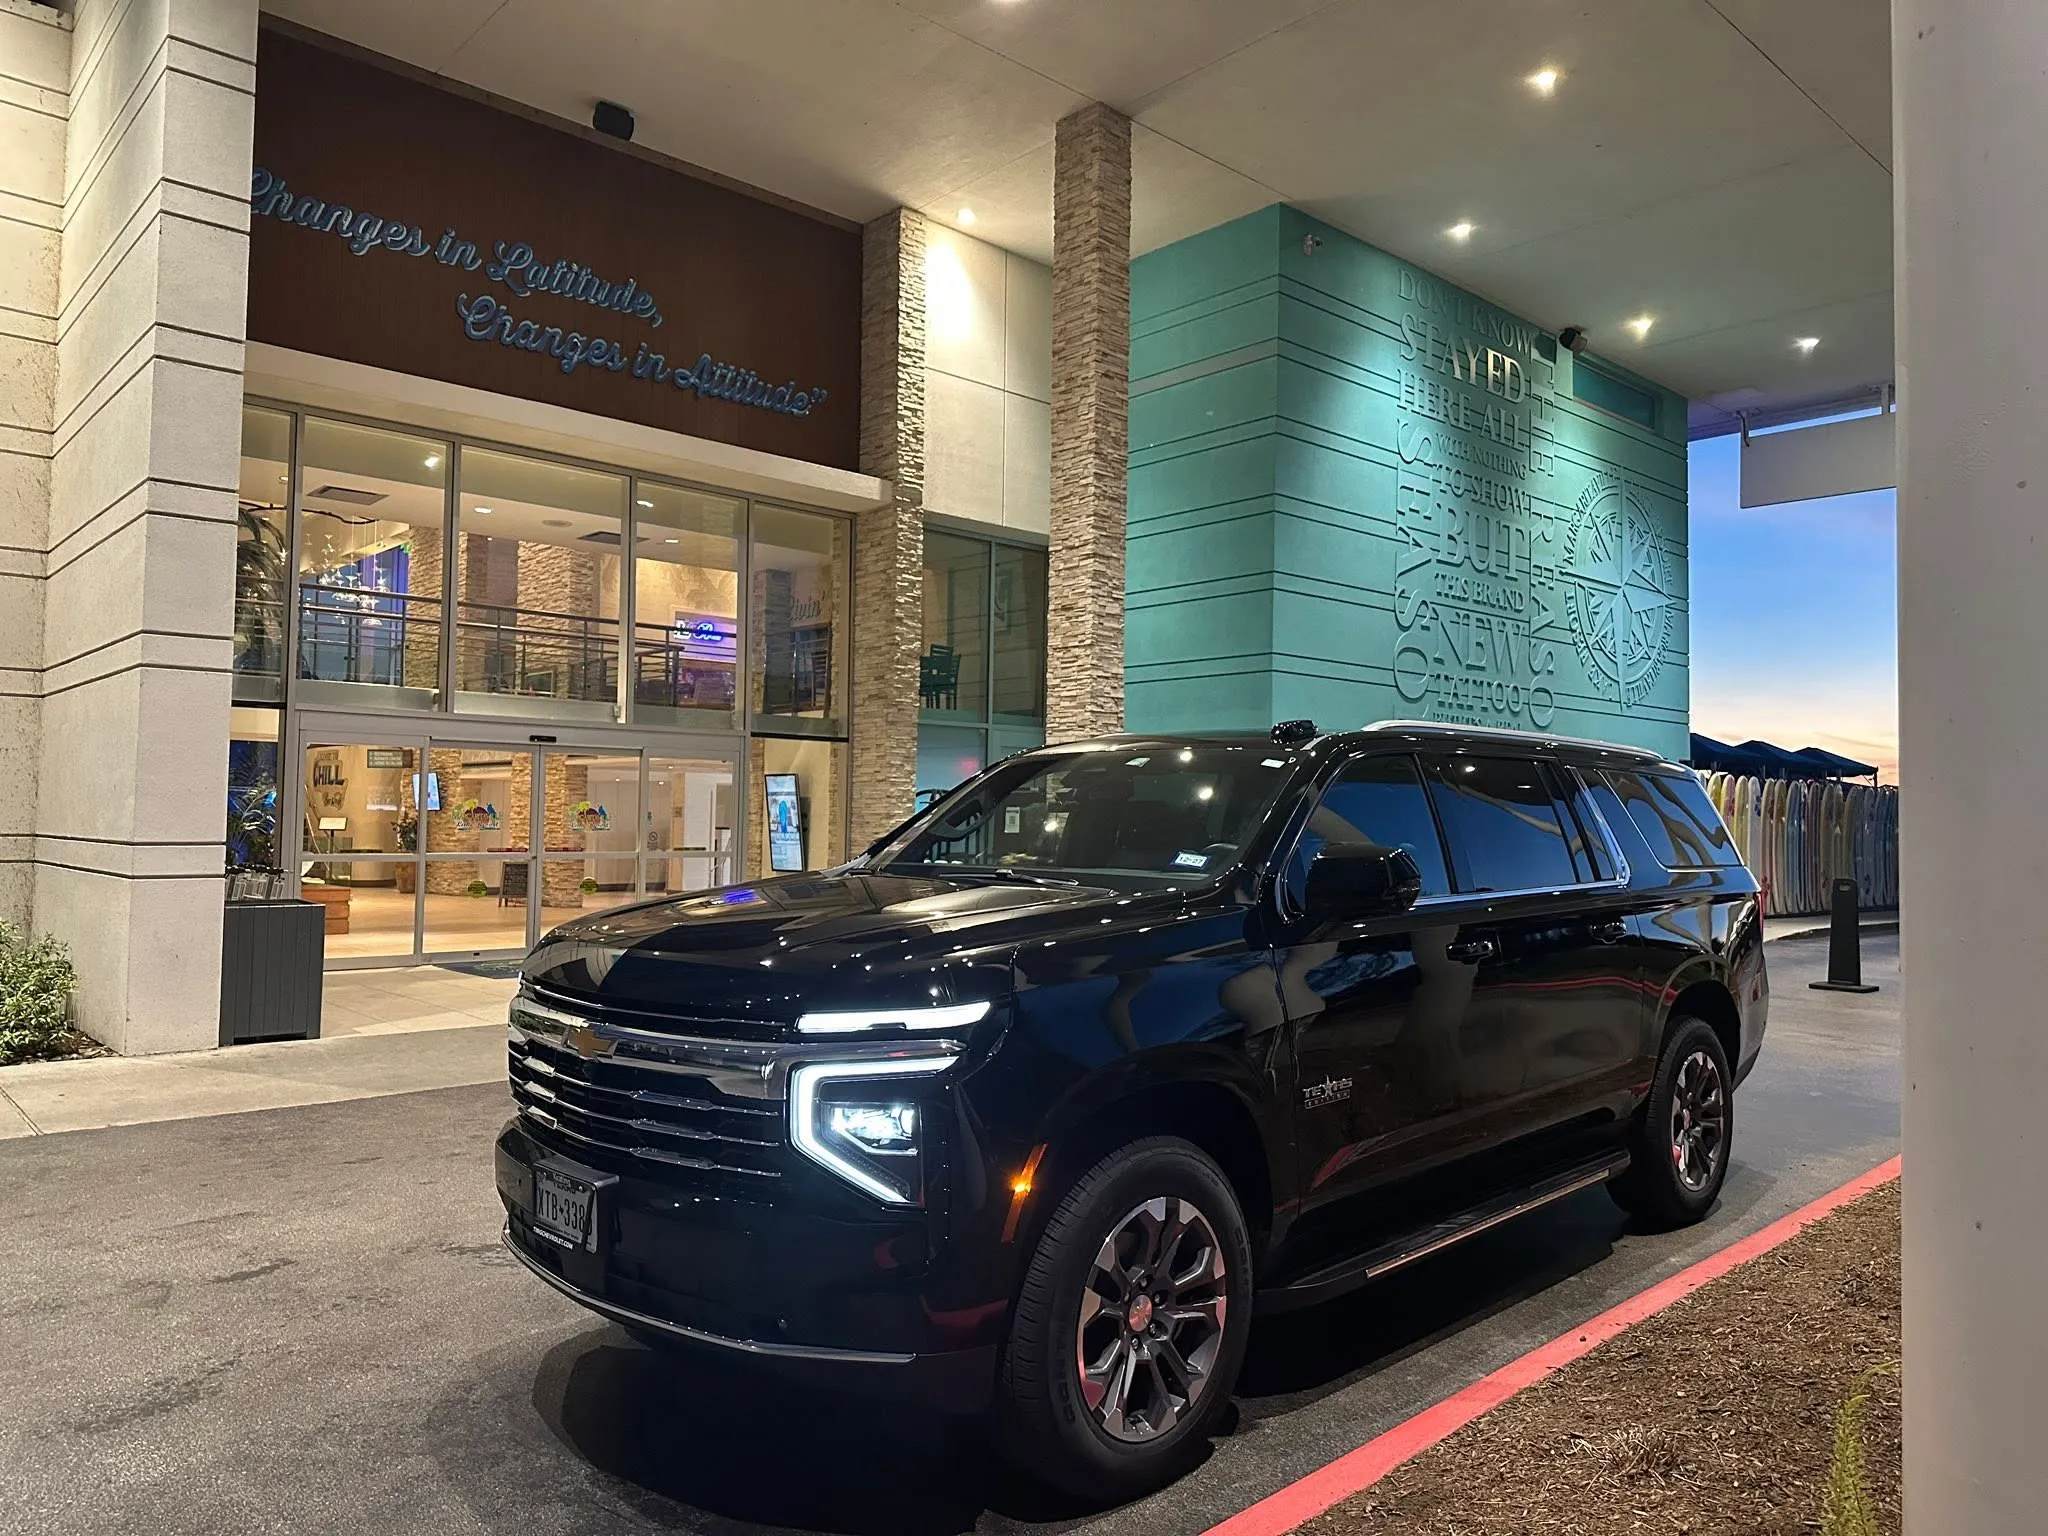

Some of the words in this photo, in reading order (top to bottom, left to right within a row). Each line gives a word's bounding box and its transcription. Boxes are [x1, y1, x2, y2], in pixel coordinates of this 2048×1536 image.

[434, 227, 481, 271] in
[486, 239, 663, 328] Latitude,
[457, 292, 626, 374] Changes
[632, 341, 672, 382] in
[1400, 312, 1526, 404] STAYED
[1472, 305, 1533, 356] KNOW
[1397, 369, 1472, 433] HERE
[1480, 403, 1524, 453] ALL
[1433, 463, 1465, 498] TO
[1471, 475, 1526, 516] SHOW
[1436, 432, 1470, 462] WITH
[1472, 444, 1526, 480] NOTHING
[1394, 419, 1433, 719] SEASO
[1435, 502, 1525, 583] BUT
[1434, 572, 1470, 603] THIS
[1472, 580, 1525, 614] BRAND
[1529, 491, 1555, 728] REASO
[1431, 606, 1525, 678] NEW
[1433, 673, 1524, 714] TATTOO
[312, 760, 345, 787] CHILL
[1302, 1074, 1353, 1099] TEXAS
